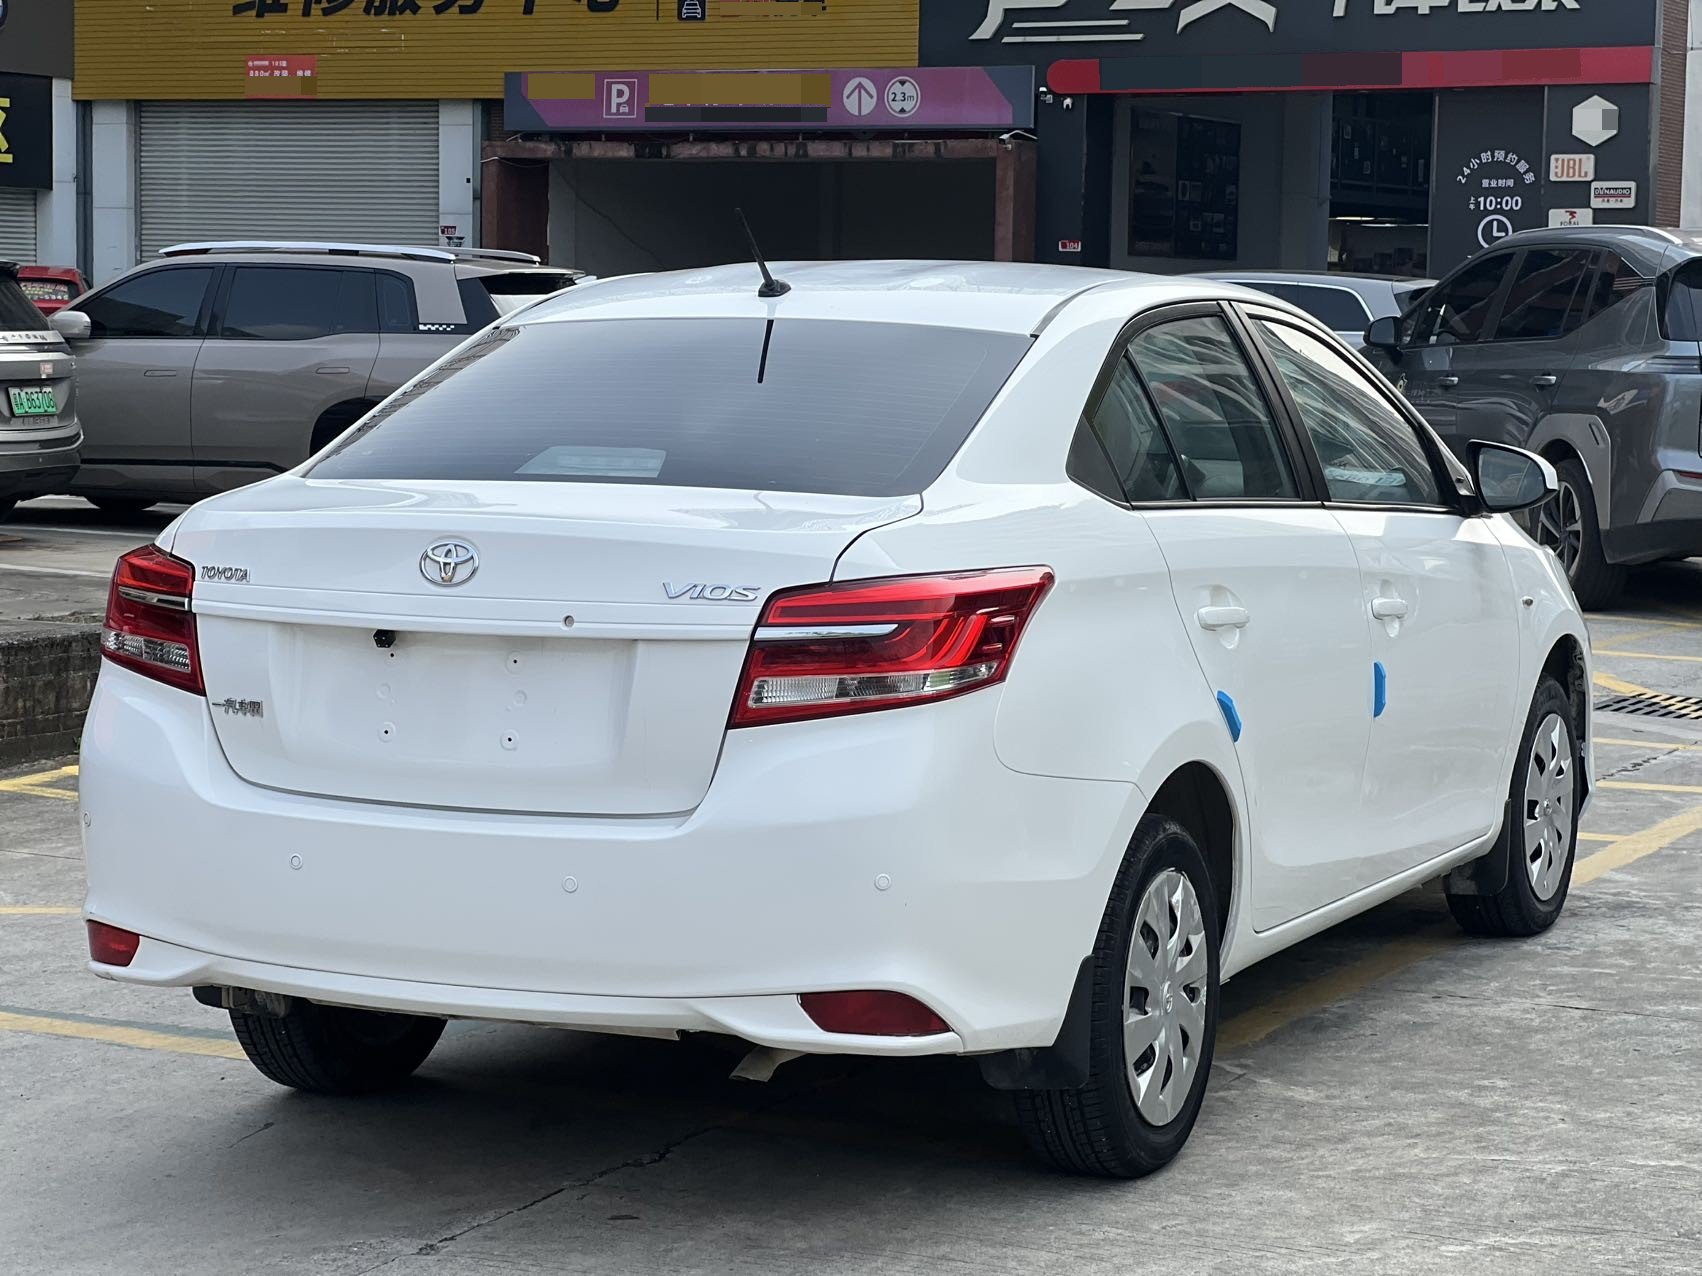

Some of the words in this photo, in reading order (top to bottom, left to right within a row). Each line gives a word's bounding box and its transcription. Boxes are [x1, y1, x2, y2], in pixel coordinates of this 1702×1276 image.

[1456, 149, 1536, 184] 24小时预约服务
[1553, 157, 1588, 179] JBL
[1481, 178, 1515, 188] 营业时间
[1594, 187, 1631, 196] DYNAUDIO
[1477, 196, 1523, 211] 10:00
[201, 565, 251, 583] TOYOTA
[662, 581, 761, 602] VIOS
